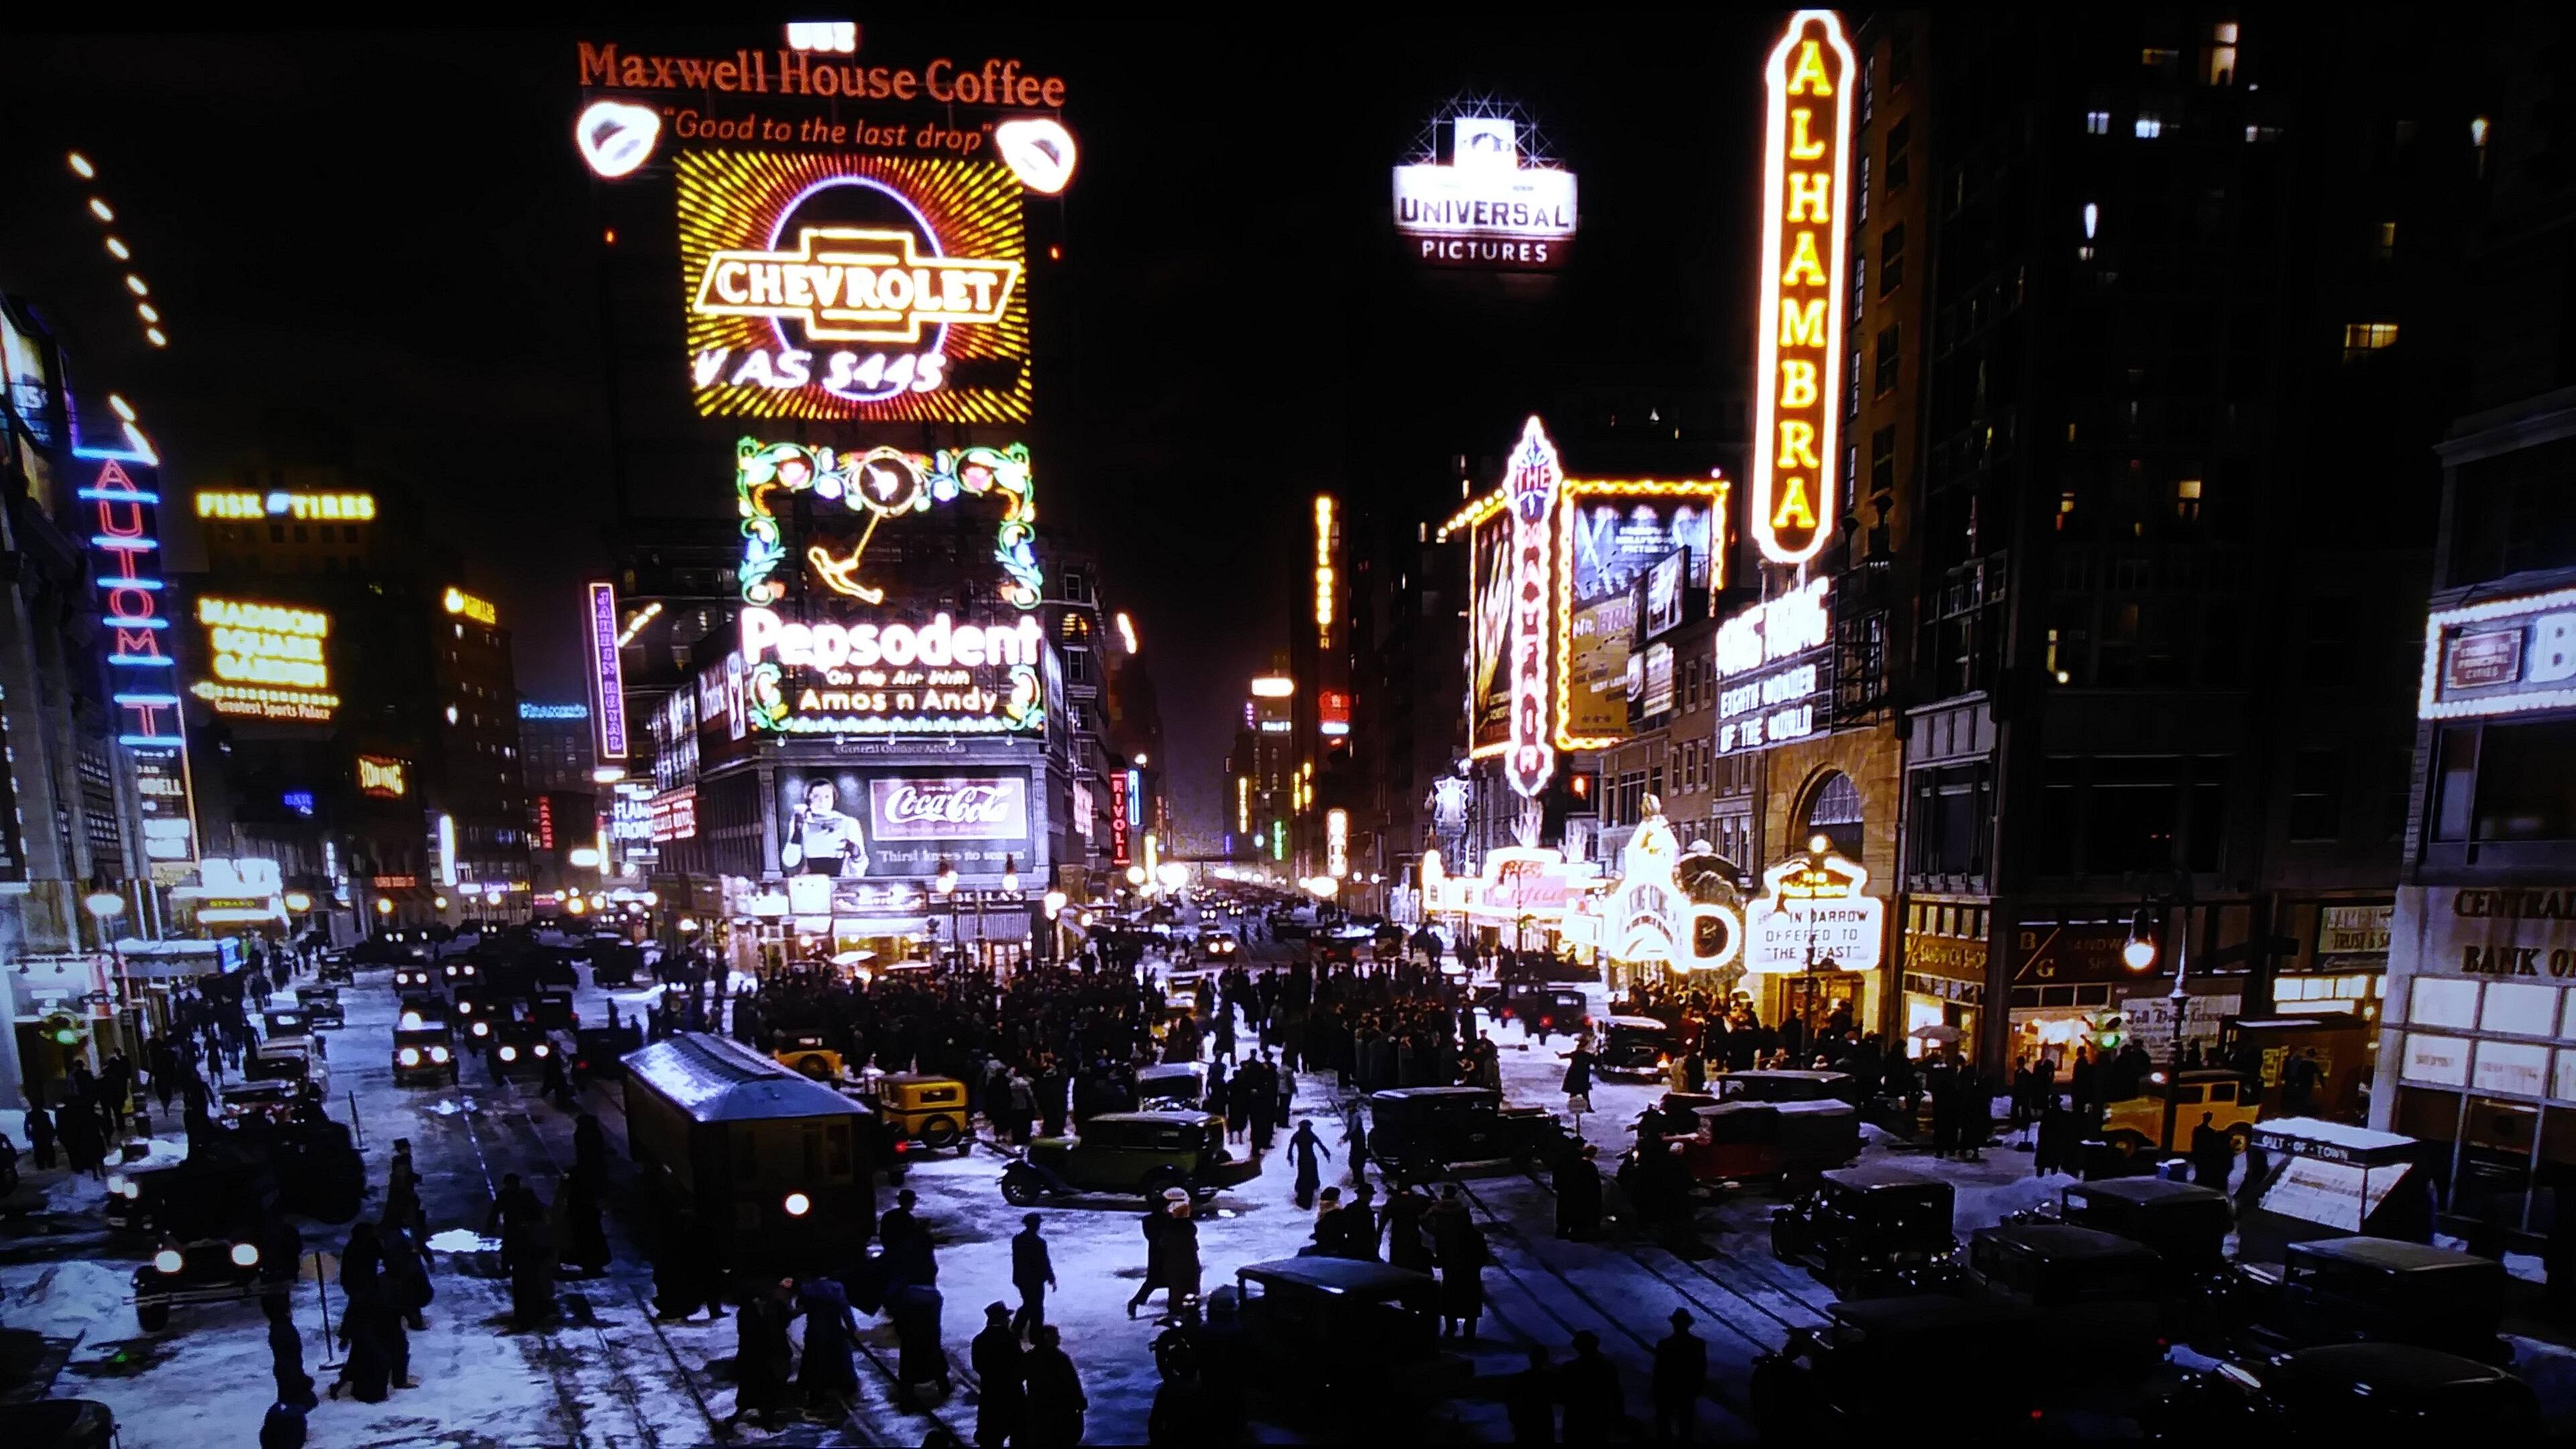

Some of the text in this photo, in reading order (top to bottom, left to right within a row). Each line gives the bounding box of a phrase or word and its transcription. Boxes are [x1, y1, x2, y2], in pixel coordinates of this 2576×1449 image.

[576, 41, 1067, 108] Maxwell House Coffee
[763, 119, 791, 142] to
[800, 113, 845, 144] the
[856, 115, 906, 147] last
[1399, 197, 1568, 227] UNIVERSAL
[1421, 241, 1548, 262] PICTURES
[716, 262, 998, 312] CHEVROLET
[1770, 39, 1833, 529] ALHAMBRA
[1515, 467, 1551, 493] THE
[199, 493, 375, 519] FISK TIRES
[95, 459, 170, 737] AUTOMT
[740, 606, 1042, 672] Pepsodent
[1517, 523, 1544, 773] MAYFAIR
[826, 669, 852, 685] On
[892, 670, 923, 686] Air
[262, 701, 297, 718] Sports
[298, 704, 331, 720] Palace
[799, 688, 998, 714] Amos n Andy
[1112, 779, 1127, 859] RIVOLI
[964, 851, 981, 862] no
[1841, 928, 1858, 941] TO
[2035, 957, 2056, 977] G
[2461, 945, 2542, 976] BANK
